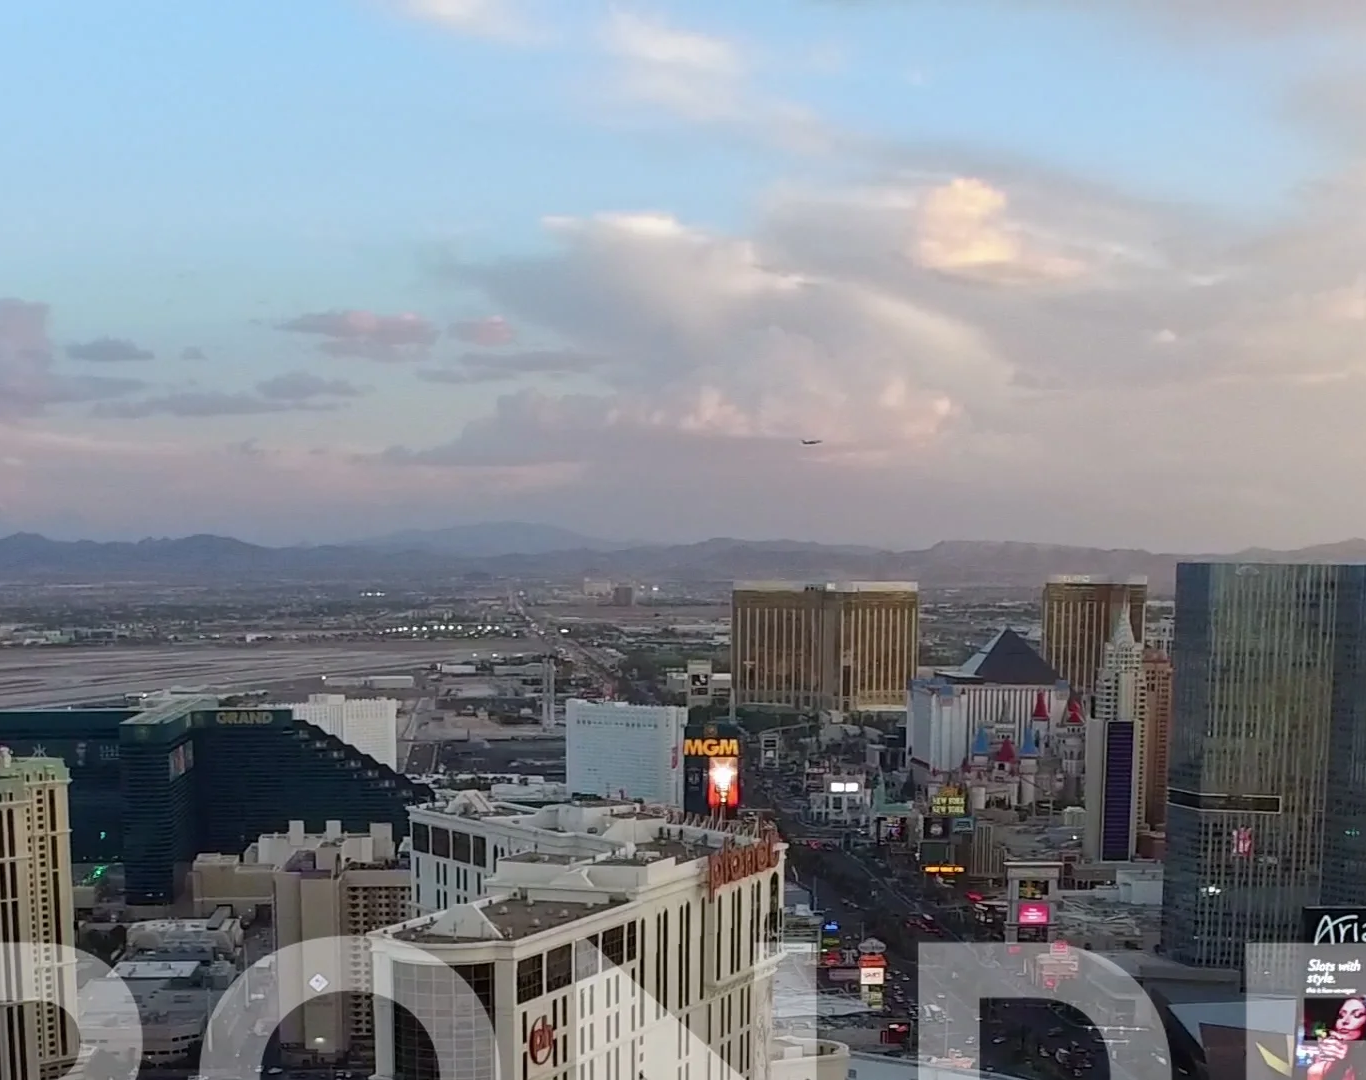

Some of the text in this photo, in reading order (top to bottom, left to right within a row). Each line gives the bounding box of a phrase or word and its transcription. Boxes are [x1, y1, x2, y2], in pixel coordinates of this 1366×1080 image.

[216, 711, 273, 725] GRAND
[683, 738, 739, 756] MGM
[1307, 959, 1361, 972] Slots with
